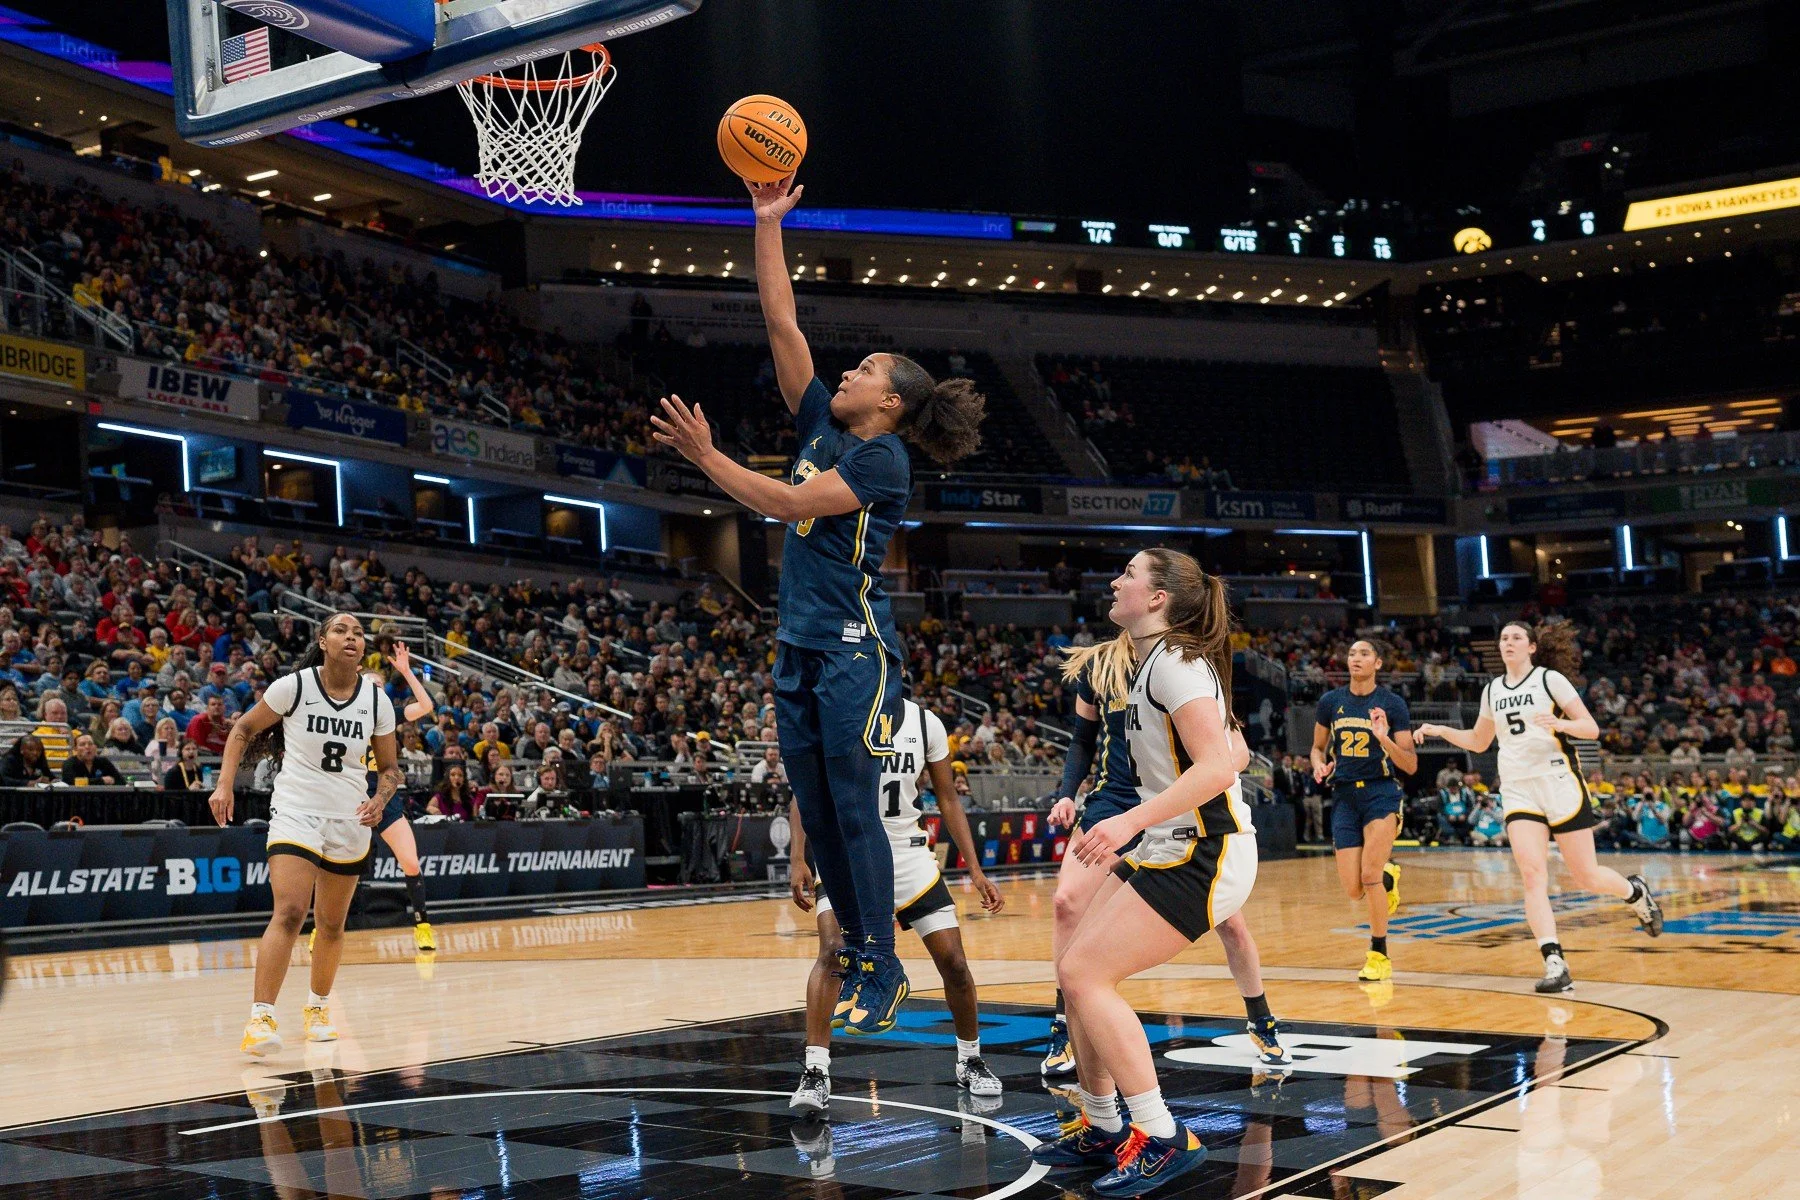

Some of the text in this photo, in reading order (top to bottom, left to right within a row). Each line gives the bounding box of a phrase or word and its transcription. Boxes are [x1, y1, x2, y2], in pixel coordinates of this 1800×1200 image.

[605, 9, 674, 37] #B1GWBBT
[515, 46, 559, 63] Allstate
[413, 78, 453, 95] Allstate
[317, 104, 356, 118] Allstate
[744, 123, 796, 167] Wilson
[1676, 201, 1713, 215] IOWA
[1716, 185, 1799, 209] HAWKEYES
[1088, 228, 1112, 243] 1/4
[0, 344, 77, 379] BRIDGE
[147, 365, 232, 402] IBEW
[147, 391, 197, 407] LOCAL
[335, 403, 377, 436] Kroger
[433, 421, 482, 458] aes
[484, 440, 534, 467] Indiana
[1071, 495, 1143, 511] SECTION
[1215, 494, 1265, 517] ksm
[1495, 693, 1535, 712] IOWA
[306, 714, 364, 740] IOWA
[1505, 711, 1526, 736] 5
[321, 741, 347, 773] 8
[1340, 730, 1370, 758] 22
[881, 752, 916, 774] WA
[882, 780, 901, 818] 1
[507, 848, 635, 873] TOURNAMENT
[7, 866, 159, 897] ALLSTATE
[165, 856, 241, 896] B1G
